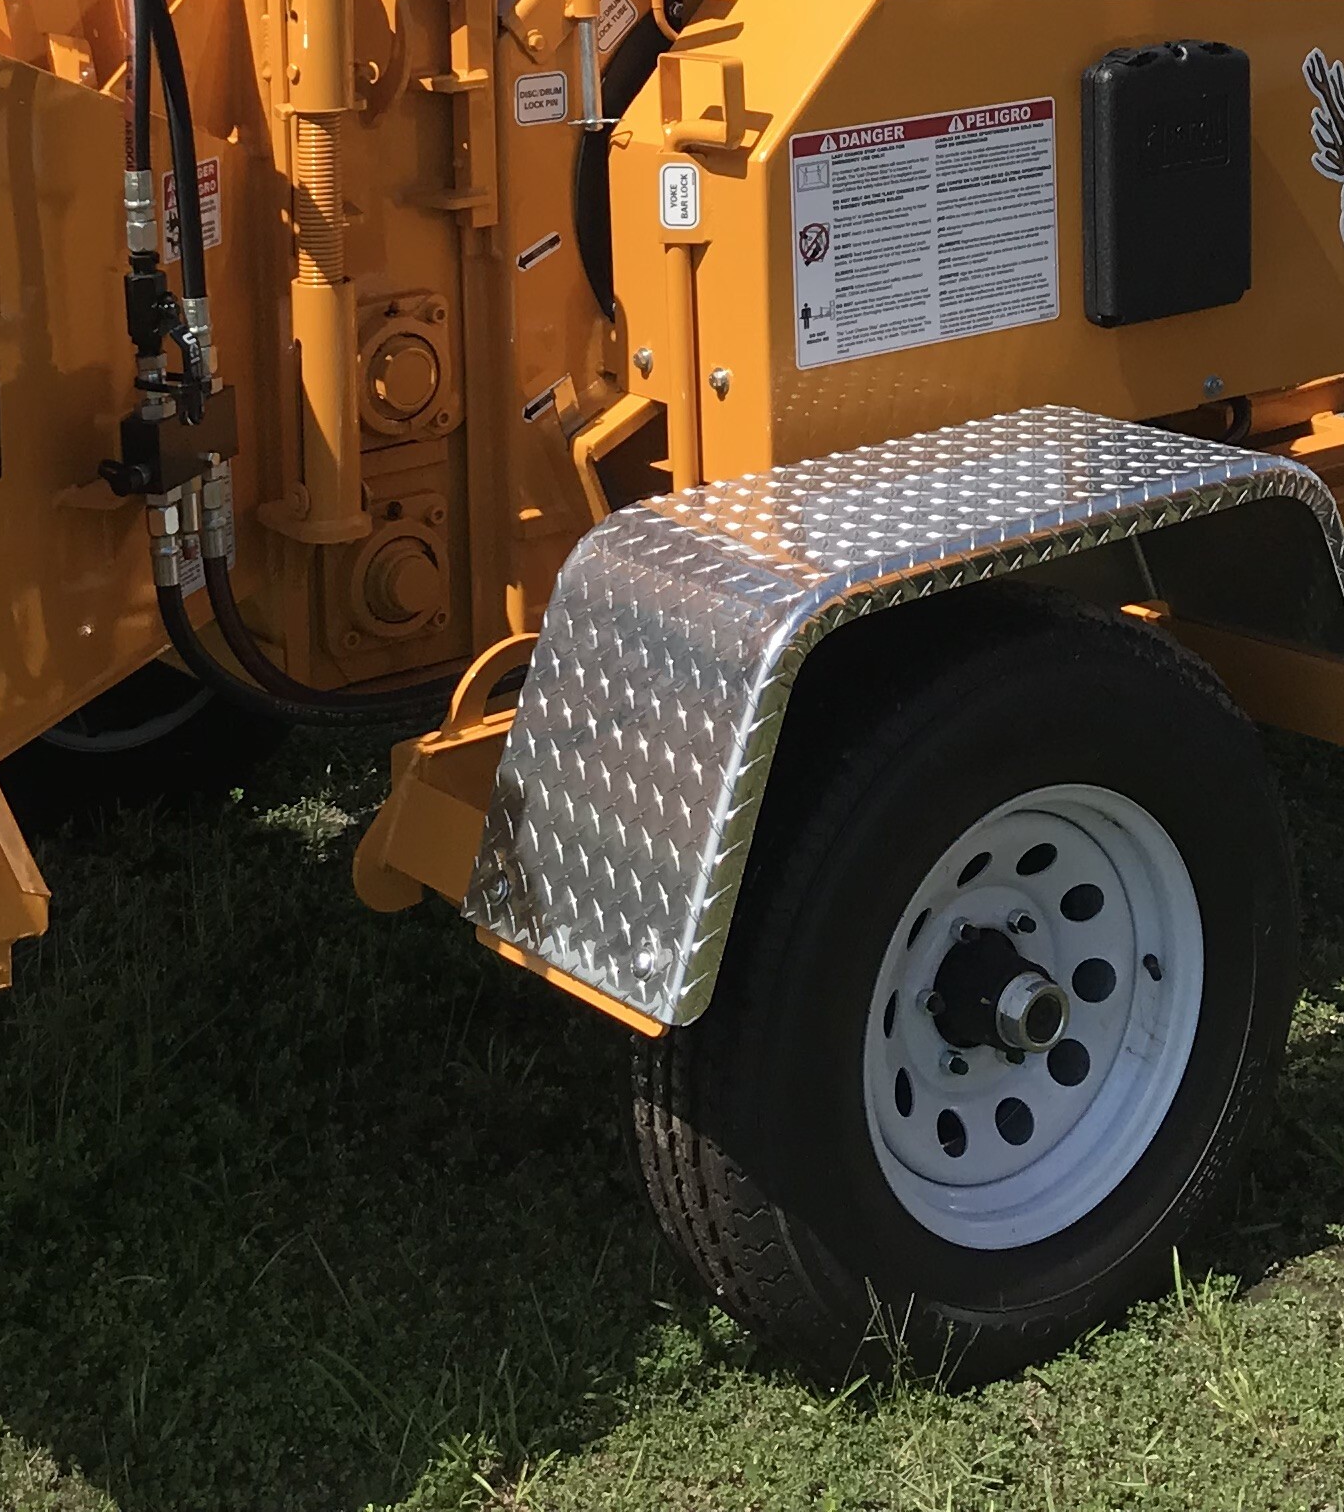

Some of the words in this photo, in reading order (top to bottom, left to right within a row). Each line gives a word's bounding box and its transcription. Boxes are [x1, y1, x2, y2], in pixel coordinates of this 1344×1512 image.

[611, 4, 629, 22] TUBE
[524, 100, 544, 110] LOCK
[545, 98, 558, 108] PIN
[839, 125, 905, 148] DANGER
[966, 106, 1031, 128] PELIGRO
[197, 163, 215, 179] GER
[681, 173, 689, 199] LOCK
[670, 184, 678, 208] YOKE
[681, 200, 689, 219] BAR
